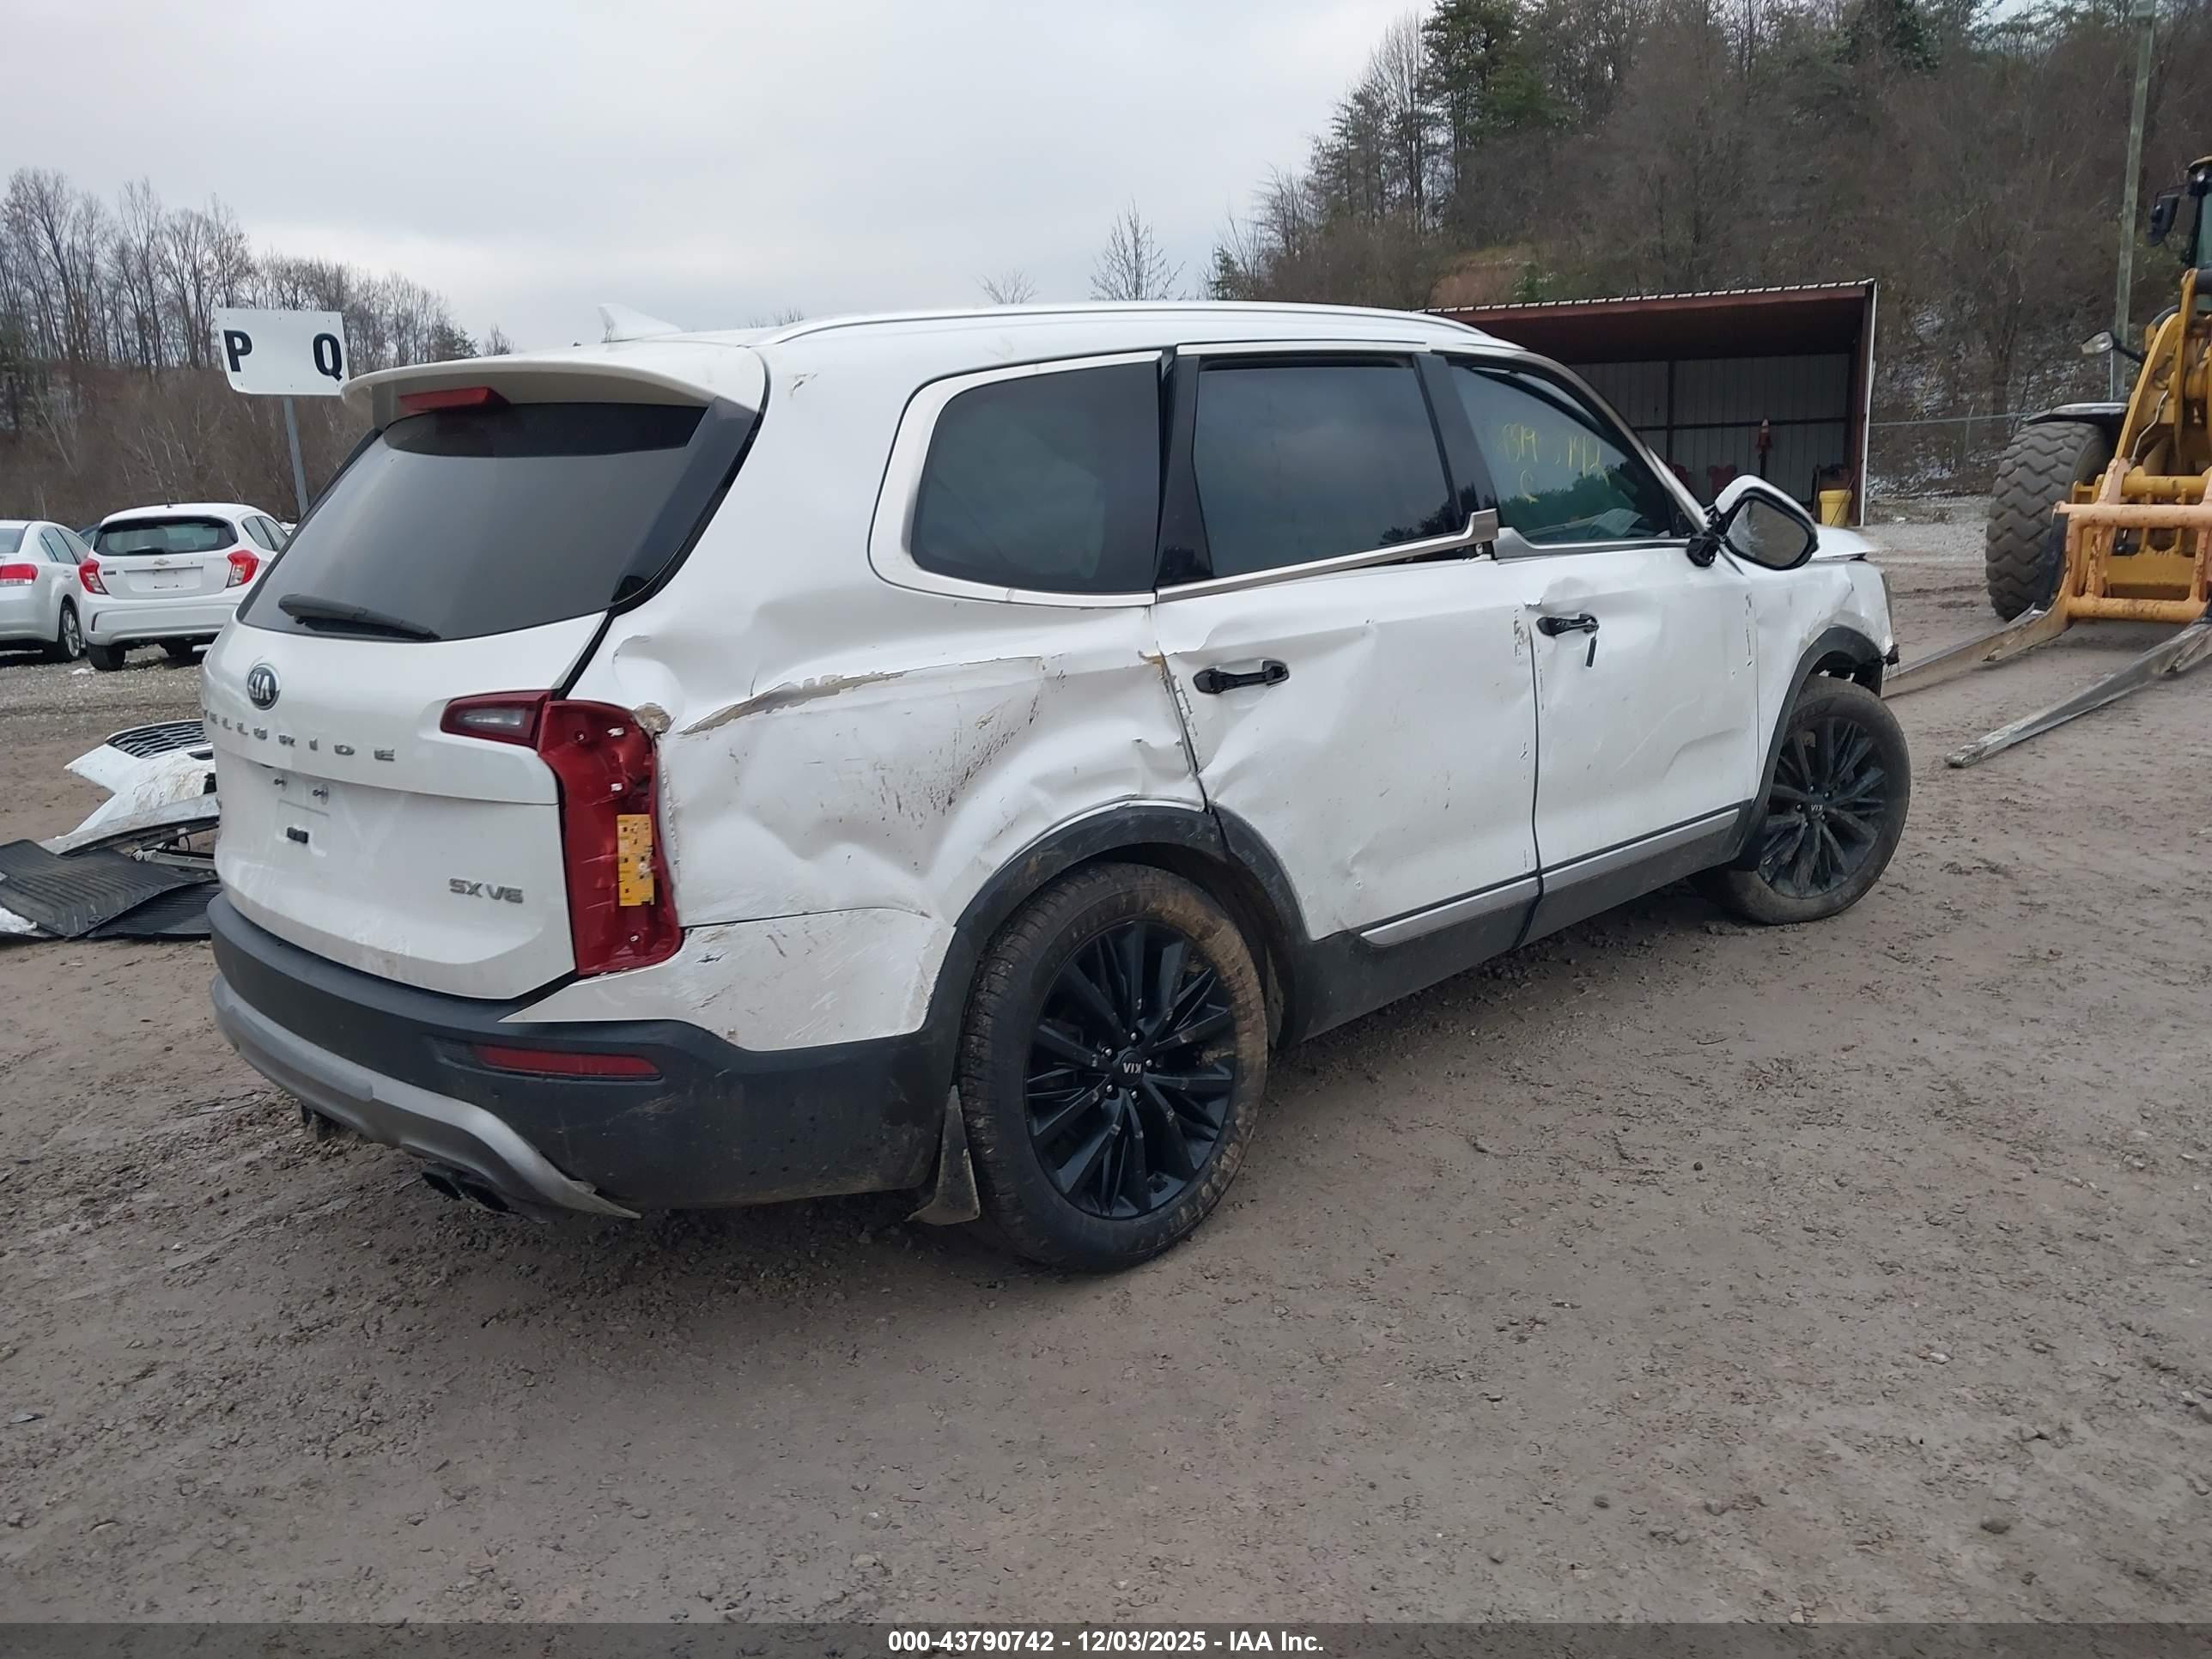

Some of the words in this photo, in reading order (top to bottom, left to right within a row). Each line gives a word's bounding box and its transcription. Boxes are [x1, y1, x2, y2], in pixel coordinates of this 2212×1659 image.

[223, 330, 252, 372] P
[313, 333, 343, 381] Q
[248, 673, 271, 700] KIA
[449, 878, 483, 898] SX
[485, 884, 523, 904] V6
[1122, 1061, 1142, 1073] KIA
